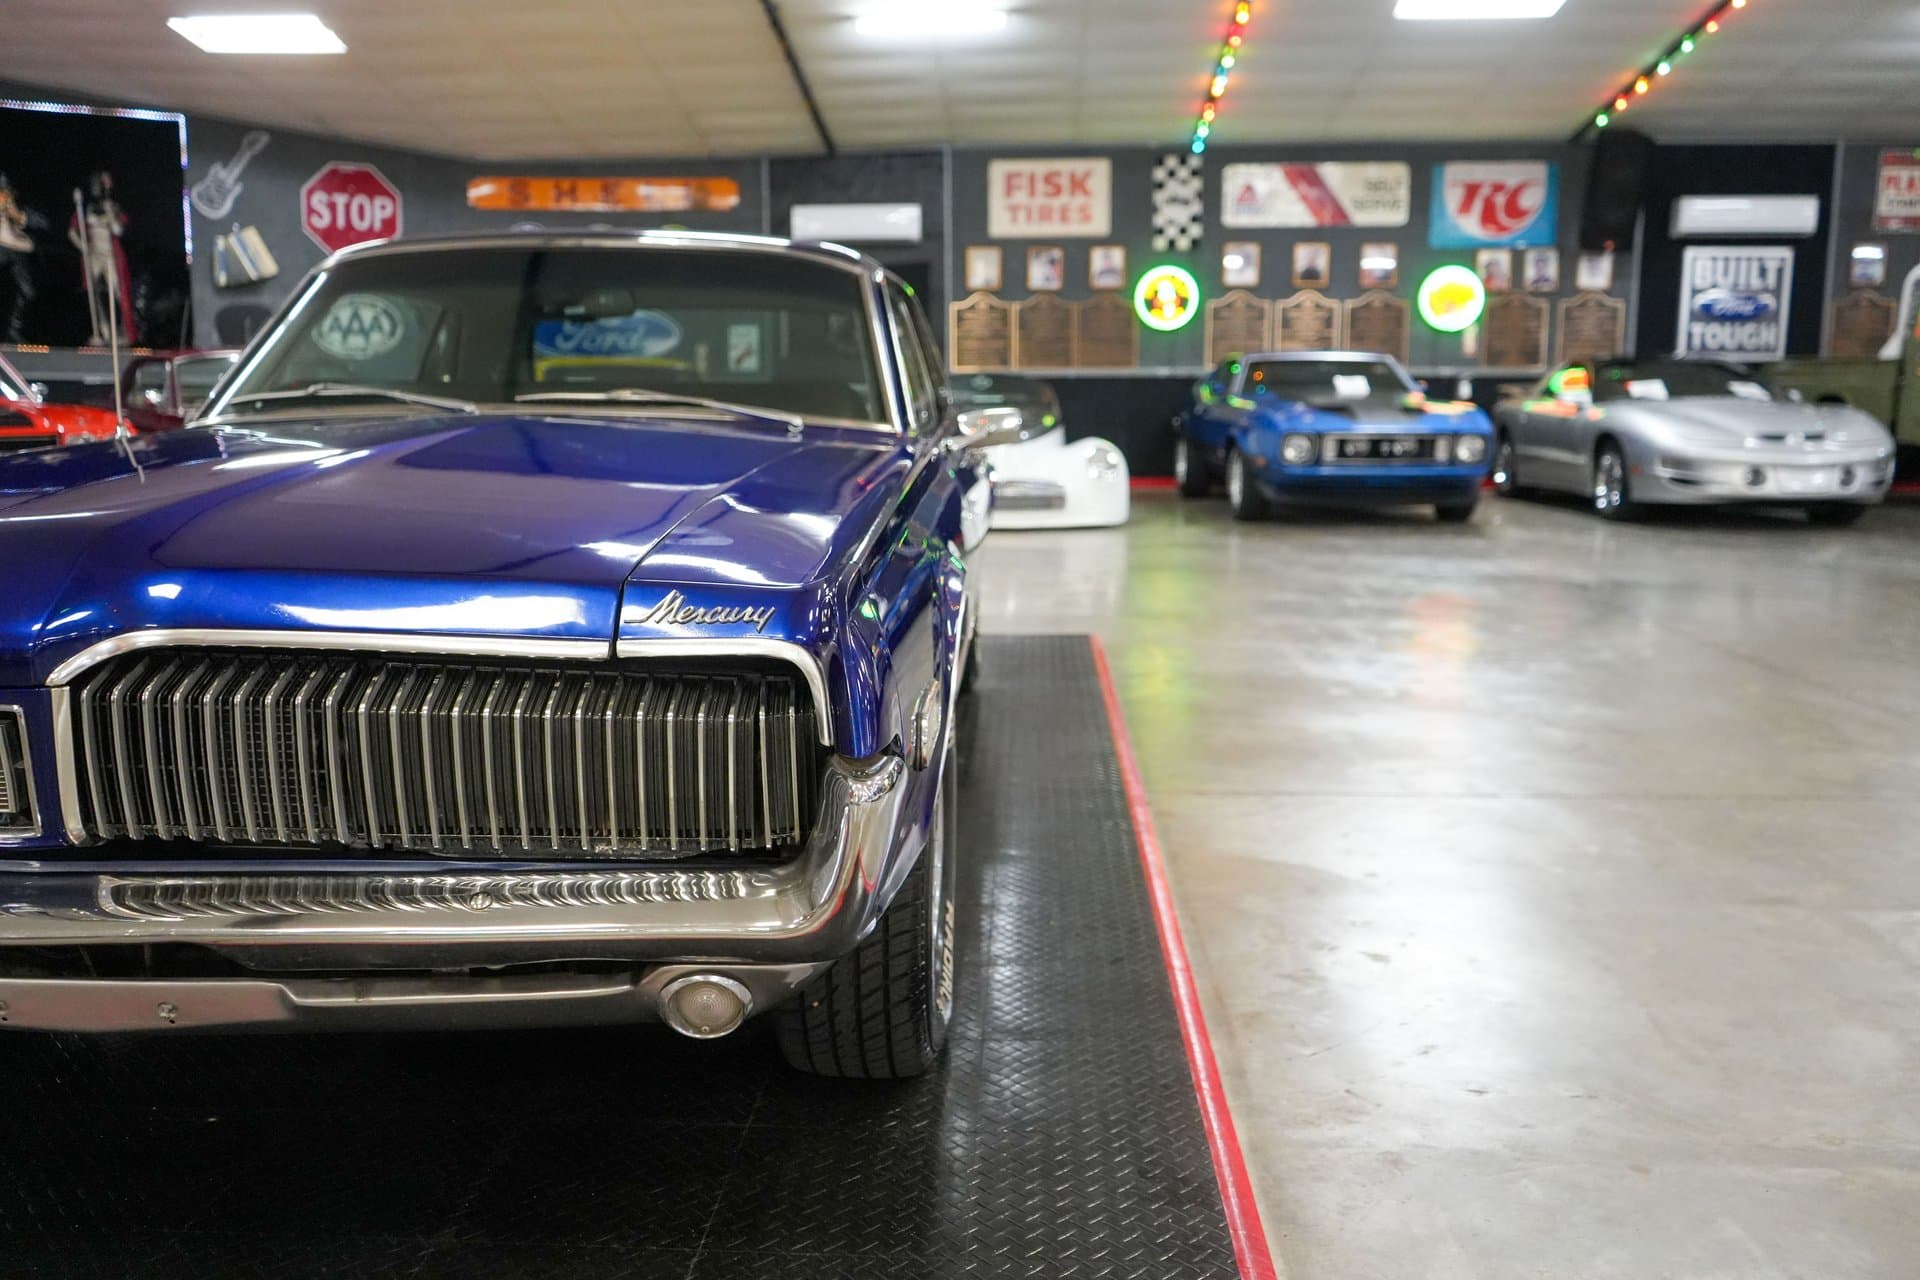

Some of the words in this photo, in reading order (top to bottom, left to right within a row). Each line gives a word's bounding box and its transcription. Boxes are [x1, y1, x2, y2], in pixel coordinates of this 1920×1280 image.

[1005, 170, 1092, 198] FISK
[310, 190, 394, 232] STOP
[1008, 204, 1092, 224] TIRES
[1450, 180, 1540, 234] RC
[1693, 257, 1783, 290] BUILT
[326, 306, 385, 346] AAA
[555, 319, 647, 350] Ford
[1690, 321, 1778, 351] TOUGH
[624, 589, 776, 634] Mercury
